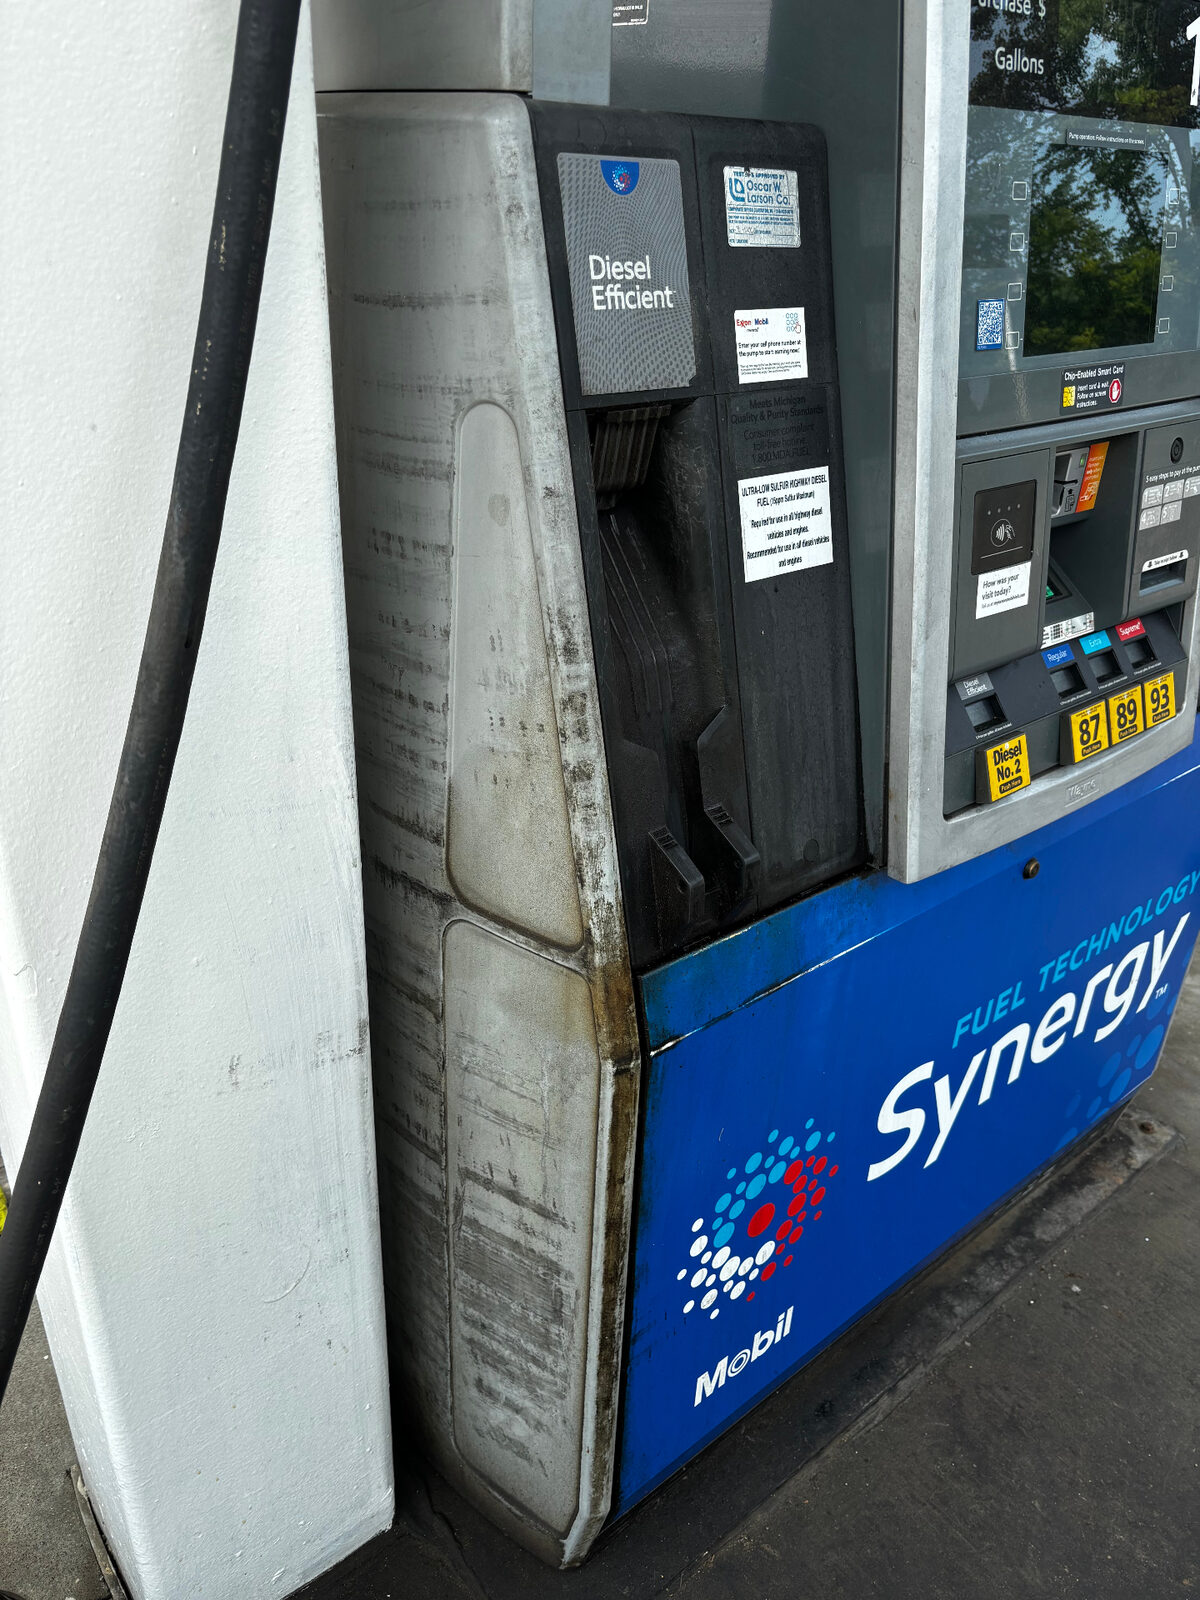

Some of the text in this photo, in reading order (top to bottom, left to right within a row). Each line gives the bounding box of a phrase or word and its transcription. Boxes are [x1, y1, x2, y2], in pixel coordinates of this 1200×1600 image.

[995, 46, 1044, 75] Gallons
[1068, 132, 1079, 140] Pump
[746, 180, 782, 193] Oscar W.
[747, 192, 773, 205] Larson
[589, 254, 651, 280] Diesel
[592, 283, 674, 310] Efficient
[736, 318, 768, 328] Exxon Mobil
[1064, 365, 1124, 381] Chip-Enabled Smart Card
[1089, 382, 1097, 390] card
[749, 396, 806, 409] Meets Michigan
[731, 405, 824, 424] Quality & Purity Standards
[1159, 472, 1169, 480] steps
[741, 474, 827, 497] ULTRA-LOW SULFUR HIGHWAY DIESEL
[1144, 491, 1148, 502] 1
[1164, 485, 1170, 497] 2
[1185, 480, 1190, 492] 3
[757, 497, 769, 507] FUEL
[751, 517, 768, 529] Required
[784, 514, 788, 522] in
[794, 510, 810, 521] highway
[811, 507, 823, 516] diesel
[1141, 511, 1146, 523] 4
[1163, 507, 1167, 518] 5
[767, 530, 783, 540] vehicles
[784, 527, 792, 536] and
[747, 545, 776, 559] Recommended
[792, 542, 796, 550] in
[802, 538, 813, 547] diesel
[814, 535, 830, 545] vehicles
[982, 574, 1019, 589] How was your
[982, 586, 1011, 600] visit today?
[1089, 637, 1102, 648] Extra
[1046, 649, 1068, 663] Regular
[963, 677, 979, 689] Diesel
[966, 684, 987, 696] Efficient
[1150, 683, 1169, 714] 93
[1117, 698, 1137, 729] 89
[1161, 710, 1169, 718] Here
[1079, 713, 1100, 746] 87
[1128, 726, 1136, 734] Here
[993, 740, 1022, 766] Diesel
[1092, 743, 1100, 751] Here
[996, 758, 1021, 782] No. 2
[1001, 778, 1021, 792] Push Here
[952, 870, 1200, 1049] FUEL TECHNOLOGY
[867, 911, 1191, 1182] Synergy
[694, 1305, 794, 1407] Mobil
